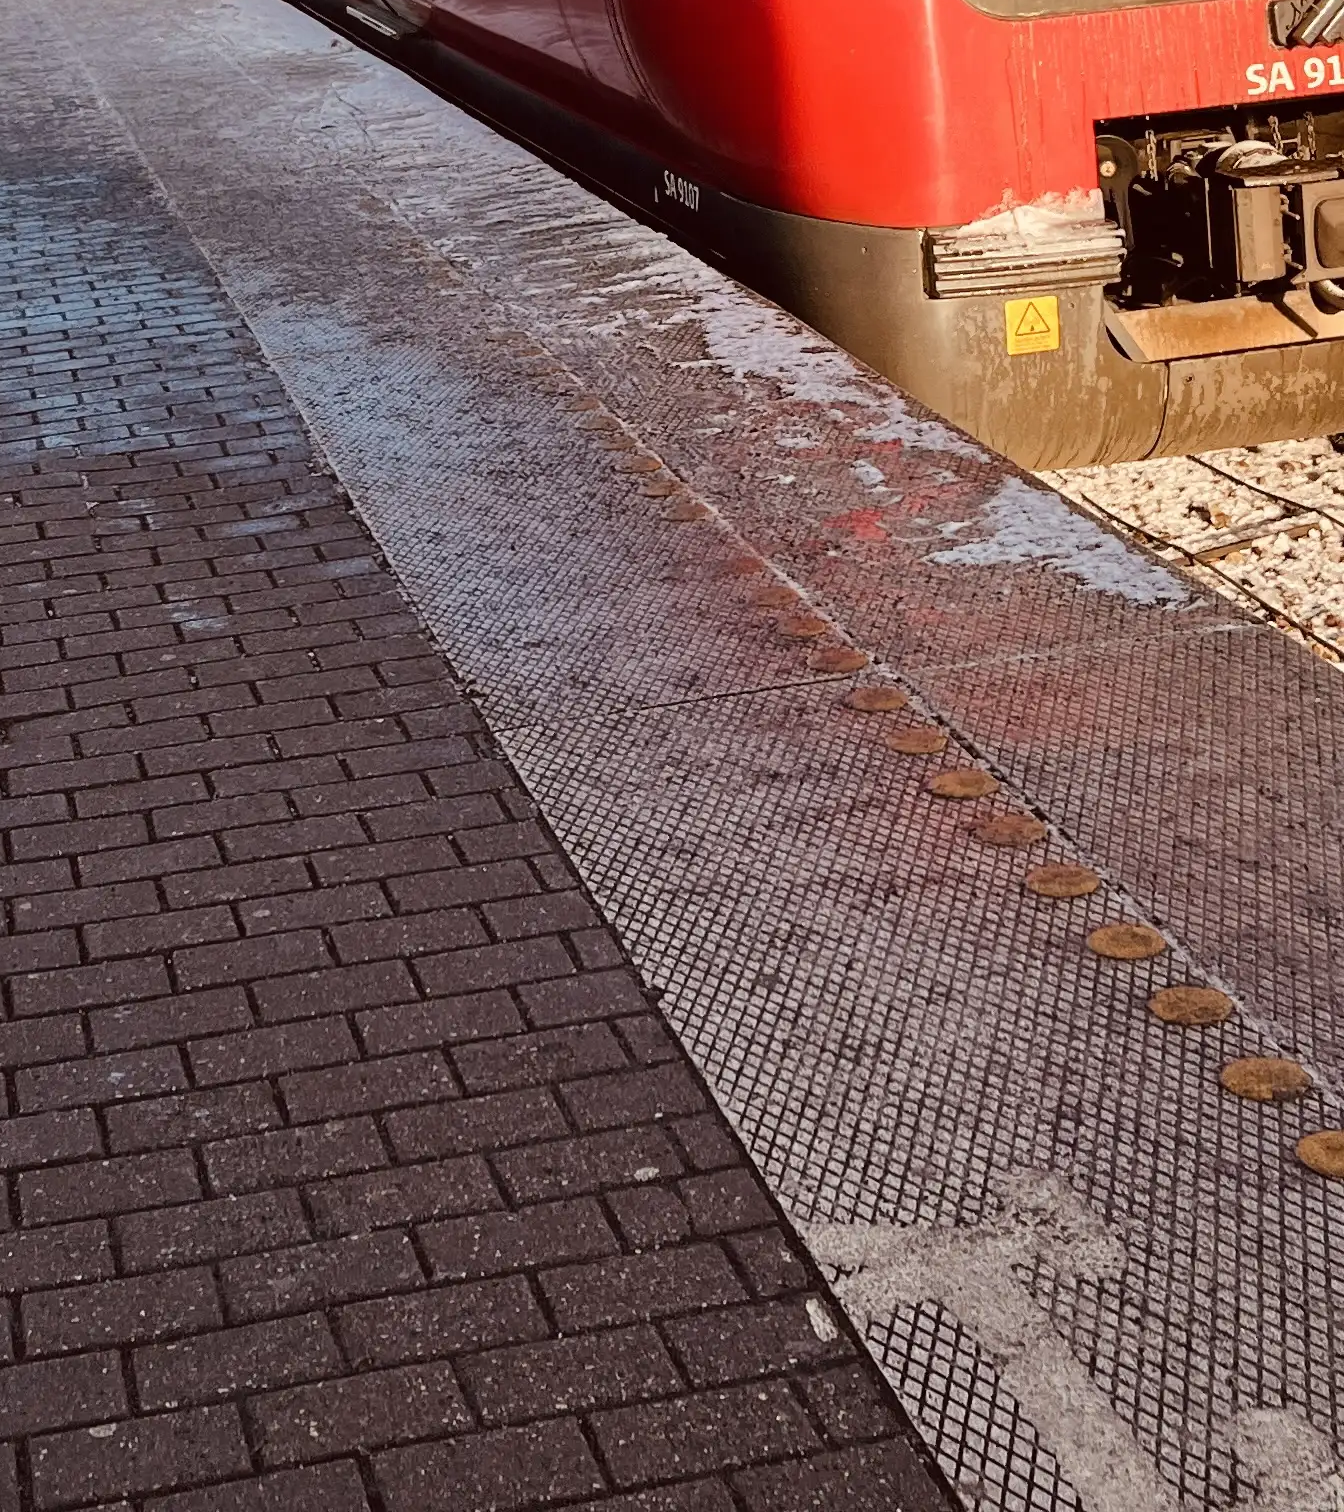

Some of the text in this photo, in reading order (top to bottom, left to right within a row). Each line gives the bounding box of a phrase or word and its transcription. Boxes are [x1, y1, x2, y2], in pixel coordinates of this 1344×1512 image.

[1245, 60, 1296, 96] SA
[663, 169, 700, 213] SA 9107
